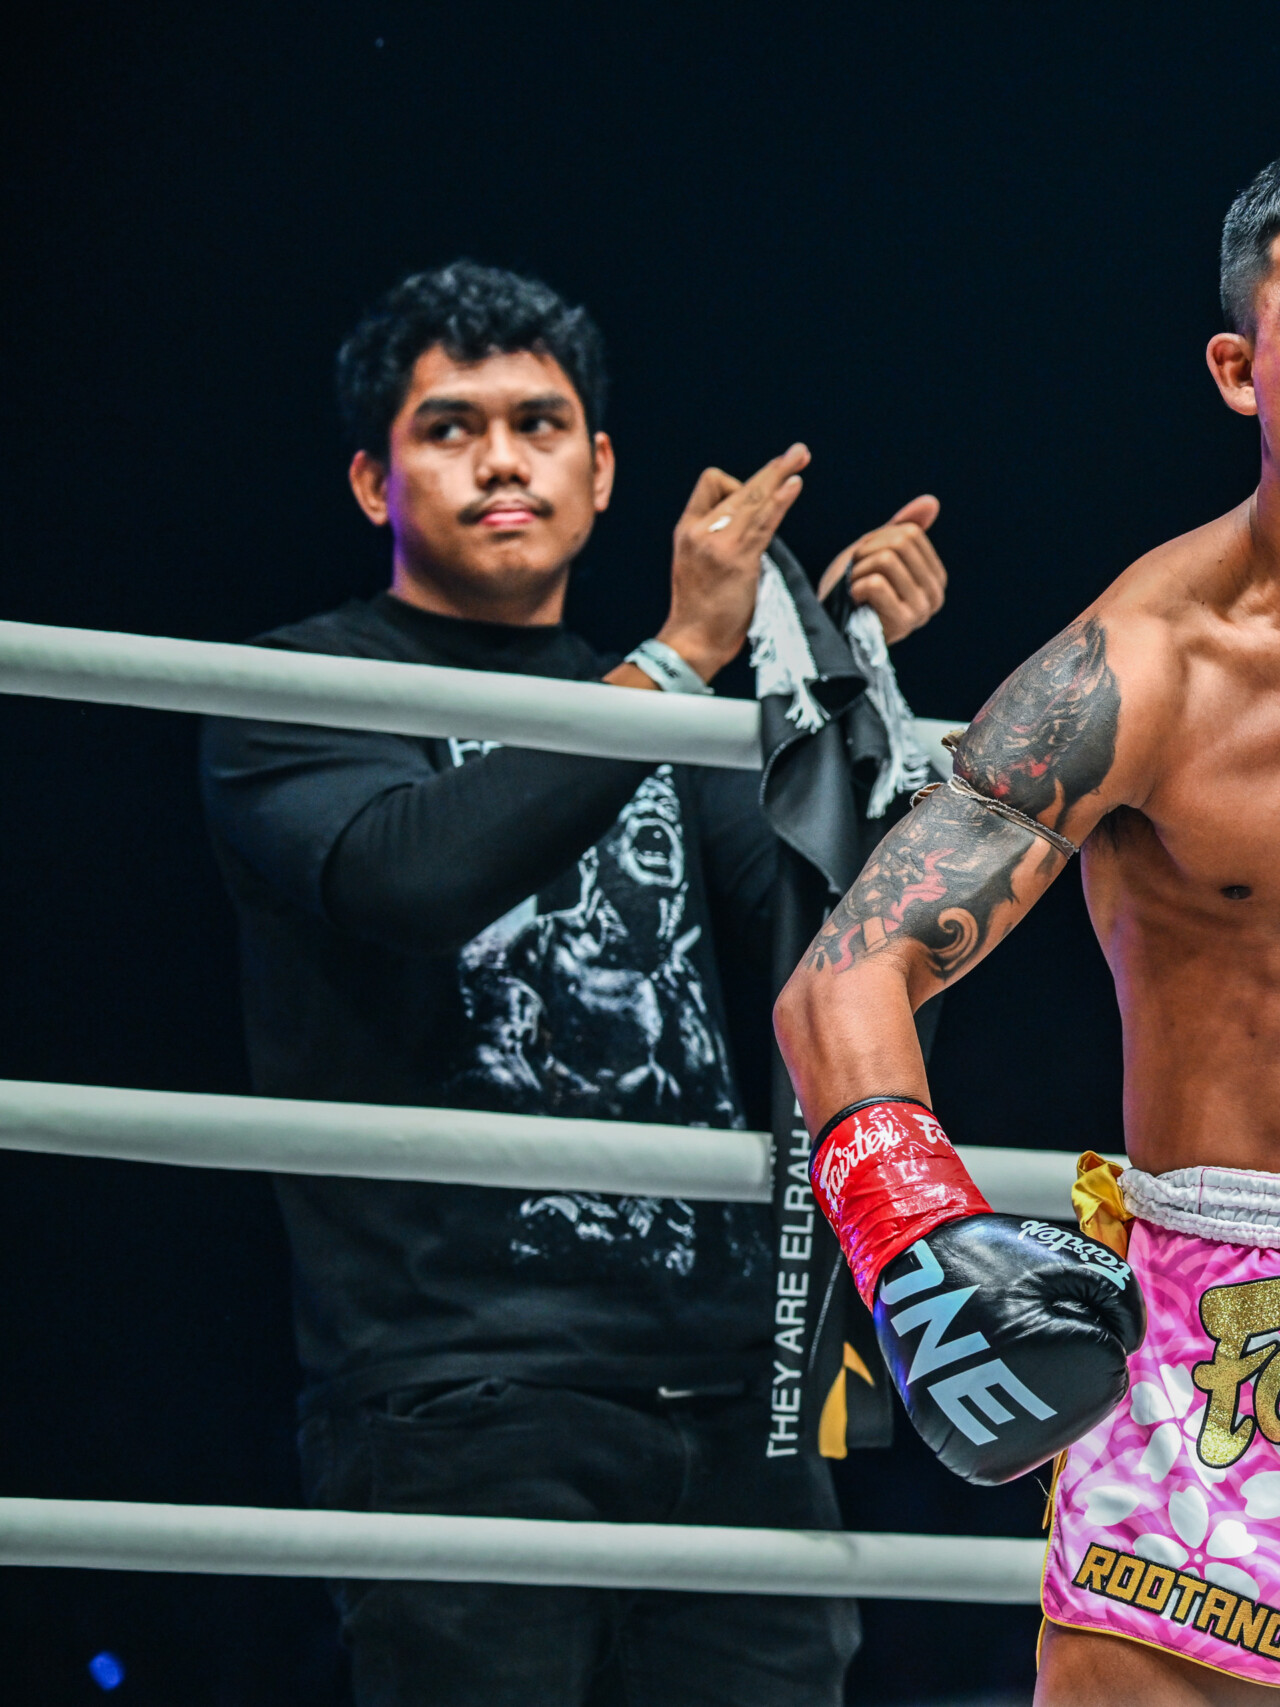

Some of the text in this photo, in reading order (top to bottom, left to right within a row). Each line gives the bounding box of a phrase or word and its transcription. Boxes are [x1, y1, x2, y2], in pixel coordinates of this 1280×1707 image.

[819, 1120, 901, 1211] Fairtex
[1019, 1219, 1133, 1291] Fairtex
[775, 1271, 809, 1353] ARE
[766, 1360, 801, 1459] THEY
